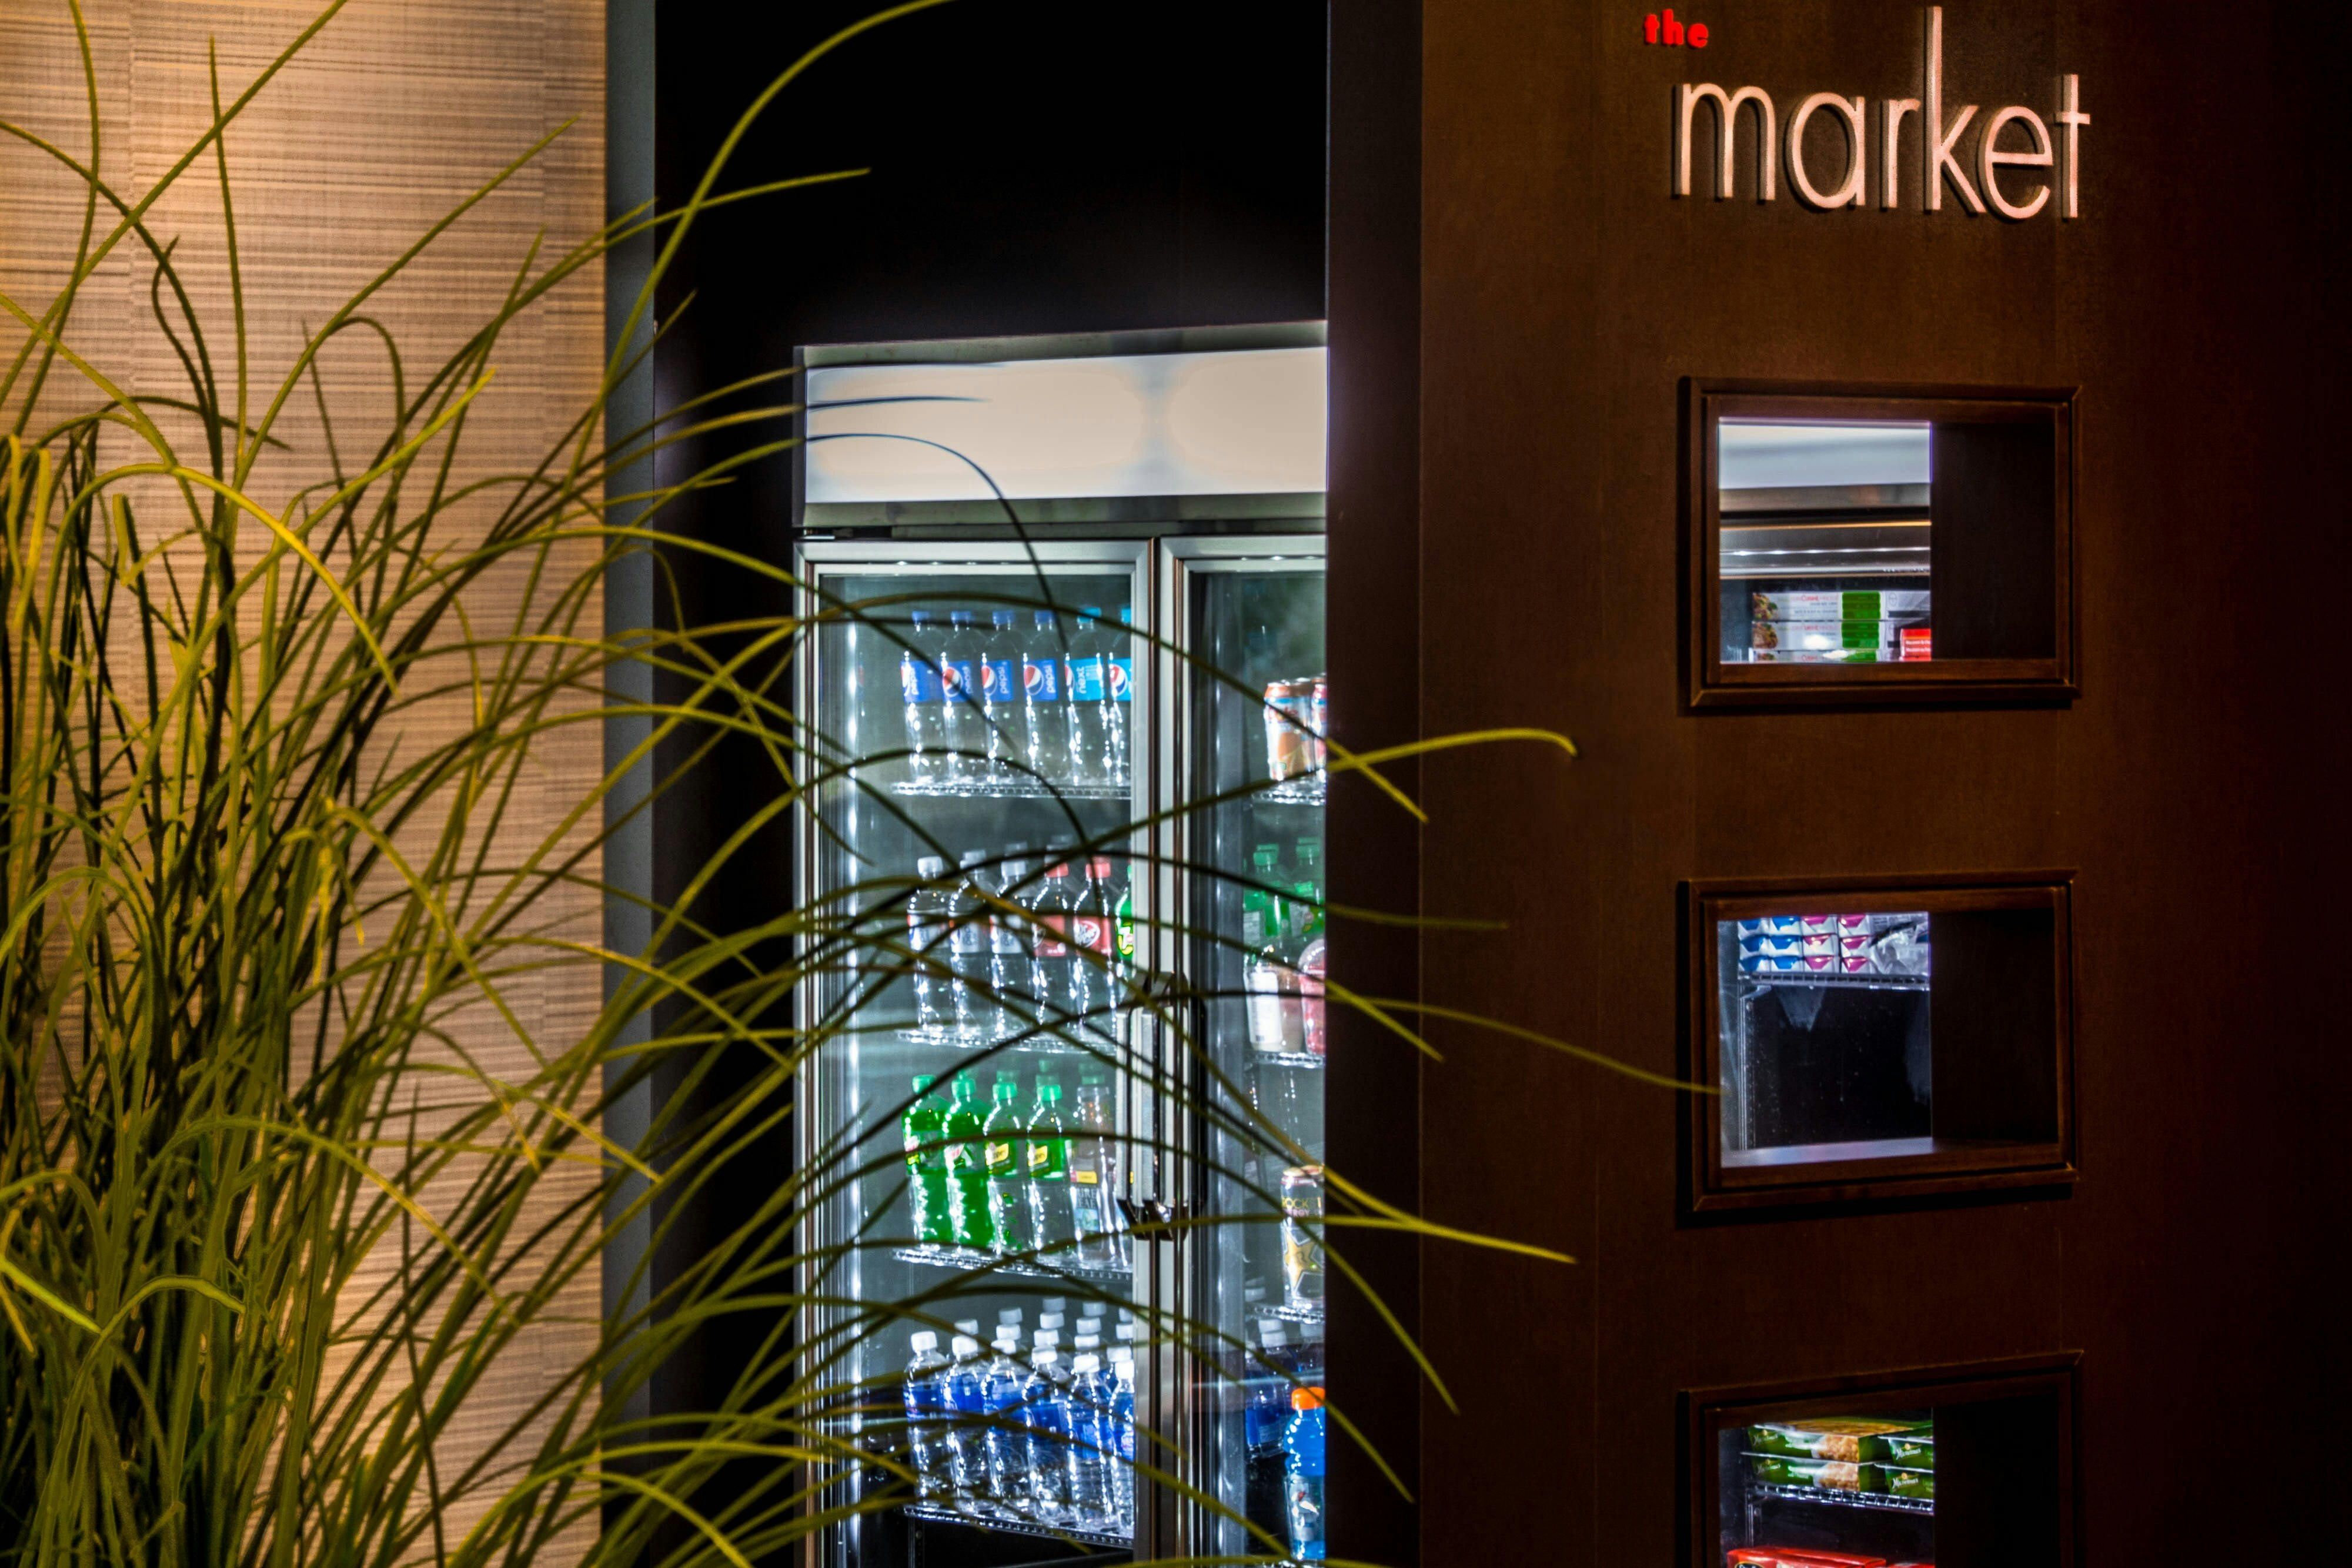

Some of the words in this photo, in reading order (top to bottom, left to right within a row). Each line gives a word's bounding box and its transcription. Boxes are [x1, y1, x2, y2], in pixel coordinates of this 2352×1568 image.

[1644, 9, 1709, 48] the
[1674, 6, 2091, 220] market
[997, 666, 1009, 694] pepsi
[1043, 665, 1056, 694] pepsi
[1076, 666, 1087, 694] next
